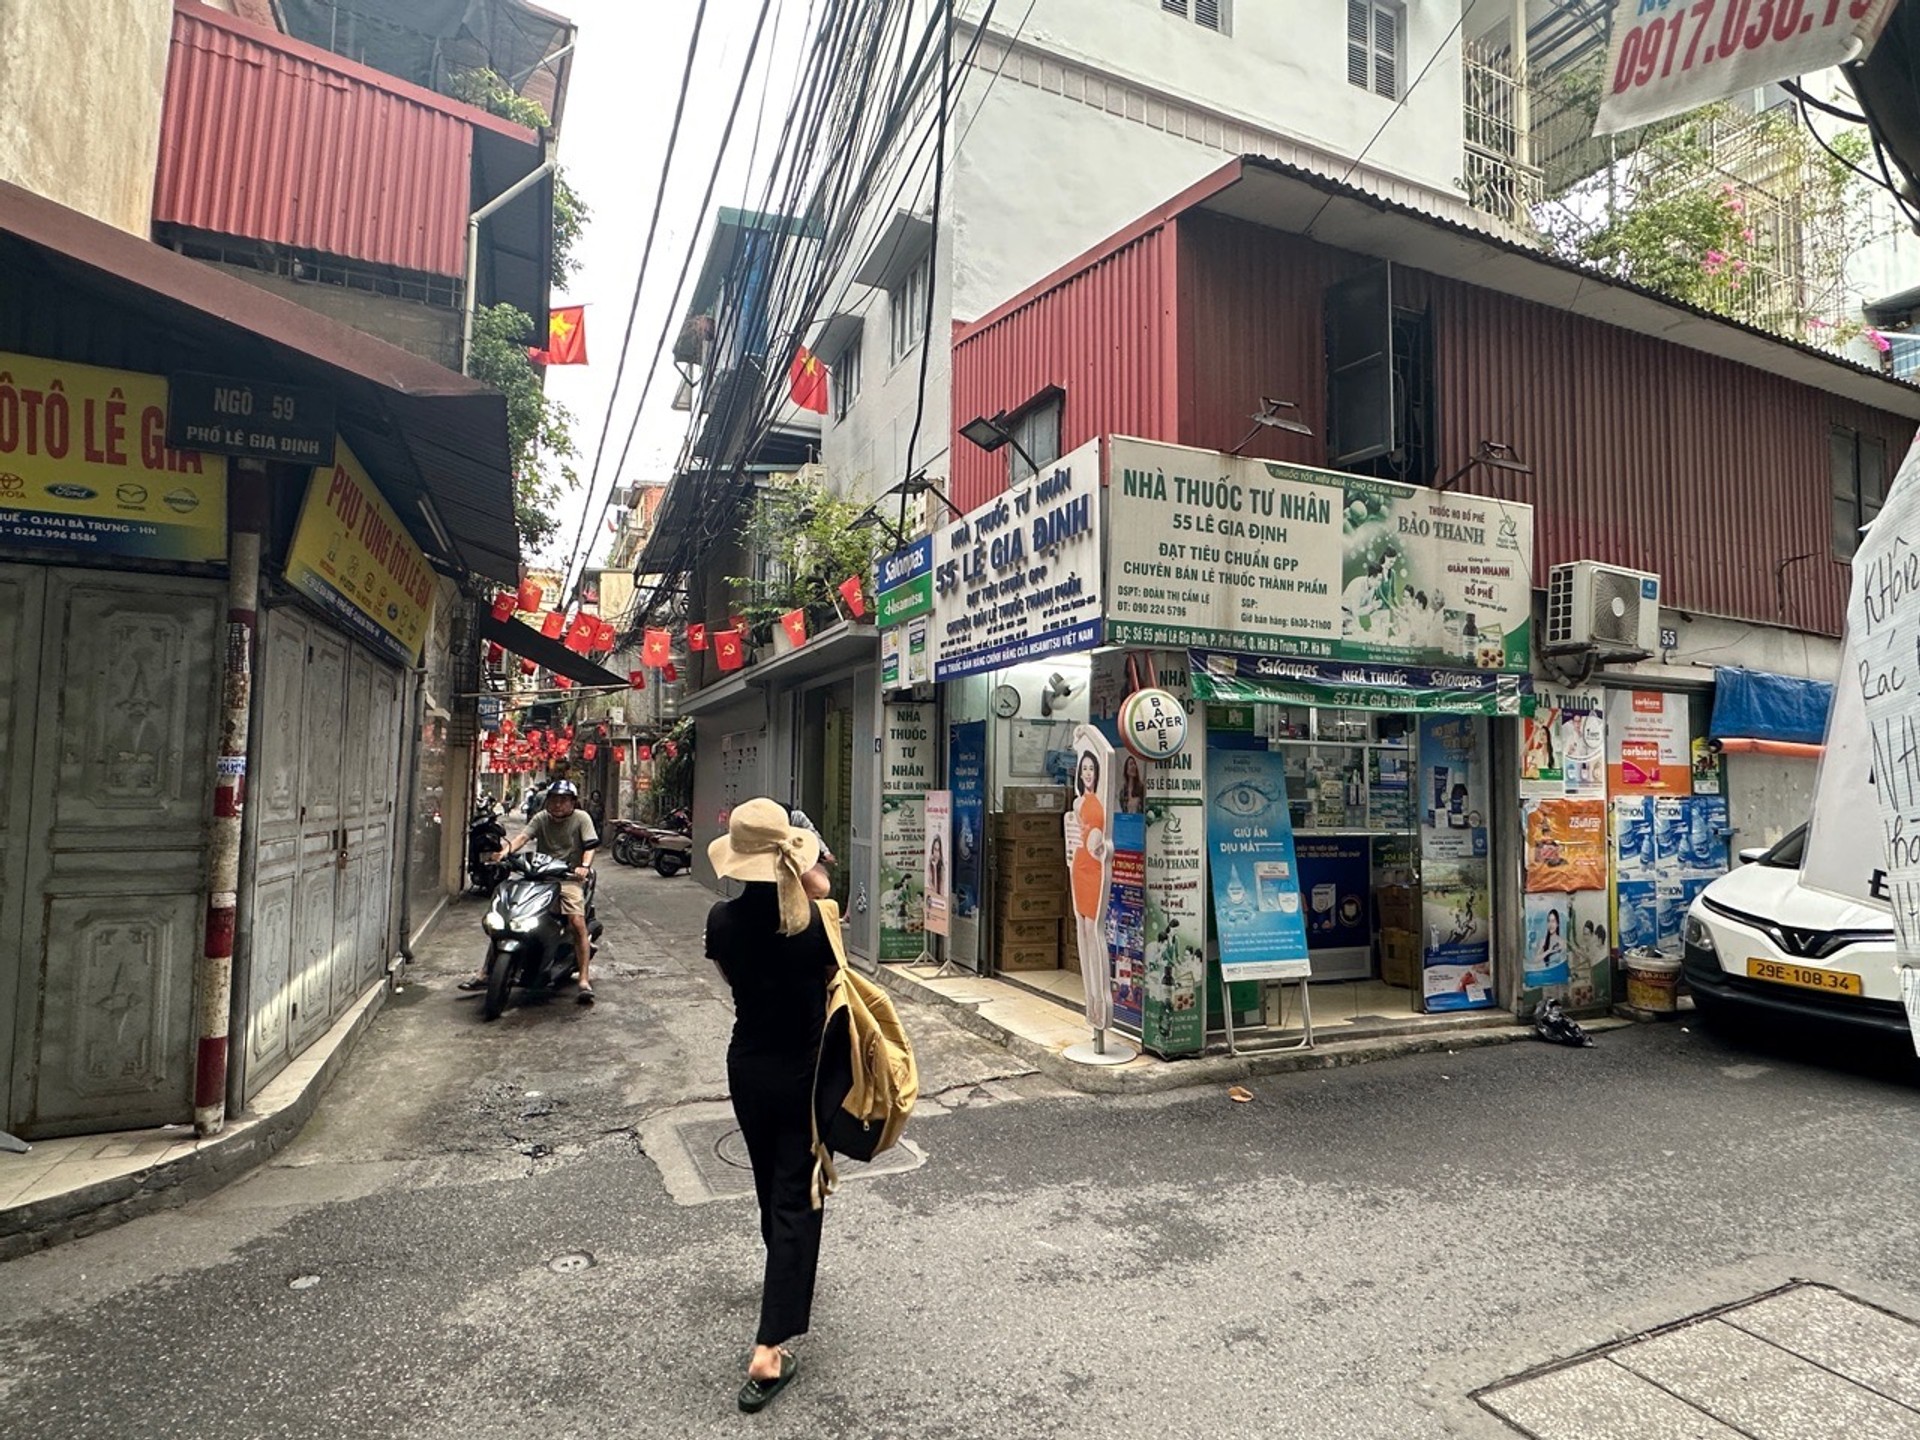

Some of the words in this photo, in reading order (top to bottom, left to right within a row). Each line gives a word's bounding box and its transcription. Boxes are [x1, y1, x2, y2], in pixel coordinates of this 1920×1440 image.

[272, 395, 295, 421] 59
[84, 387, 127, 466] LÊ
[187, 425, 222, 443] PHỐ
[225, 429, 244, 445] LÊ
[250, 434, 276, 450] GIA
[281, 437, 320, 457] ĐỊNH
[1036, 467, 1071, 505] NHÂN
[1123, 468, 1167, 501] NHÀ
[1174, 475, 1242, 514] THUỐC
[1249, 487, 1275, 517] TƯ
[1281, 491, 1330, 524] NHÂN
[326, 463, 363, 538] PHỤ
[68, 519, 85, 529] BÀ
[87, 521, 130, 533] TRƯNG
[139, 526, 157, 535] HN
[1172, 514, 1192, 530] 55
[1196, 514, 1214, 533] LÊ
[1218, 519, 1245, 538] GIA
[1249, 523, 1287, 544] ĐỊNH
[1398, 511, 1430, 536] BẢO
[1433, 521, 1485, 545] THANH
[936, 559, 958, 593] 55
[991, 527, 1024, 570] GIA
[1033, 493, 1089, 557] ĐỊNH
[1159, 542, 1186, 560] ĐẠT
[1190, 544, 1220, 562] TIÊU
[1225, 548, 1269, 569] CHUẨN
[1273, 556, 1299, 572] GPP
[1123, 561, 1171, 578] CHUYÊN
[1175, 565, 1198, 581] BÁN
[1202, 567, 1215, 583] LẺ
[1218, 571, 1255, 587] THUỐC
[1259, 576, 1294, 592] THÀNH
[1297, 577, 1328, 595] PHẨM
[1470, 565, 1480, 575] HO
[1482, 565, 1510, 577] NHANH
[1167, 589, 1181, 603] THỊ
[1132, 602, 1148, 614] 090
[1150, 604, 1166, 616] 224
[1029, 635, 1062, 655] HISAMITSU
[1062, 631, 1077, 648] VIỆT
[1078, 627, 1094, 643] NAM
[1144, 628, 1153, 643] 55
[1178, 631, 1190, 645] Gia
[1662, 630, 1675, 646] 55
[1159, 667, 1187, 688] NHÀ
[1255, 657, 1318, 679] Salonpas
[1342, 667, 1366, 683] NHÀ
[1370, 669, 1408, 686] THUỐC
[1429, 670, 1482, 690] Salonpas
[1333, 691, 1349, 705] 55
[1369, 692, 1387, 707] GIA
[890, 727, 927, 740] THUỐC
[1136, 715, 1183, 732] BAYER
[1150, 697, 1169, 752] BAYER
[901, 747, 916, 758] TƯ
[892, 763, 924, 776] NHÂN
[1147, 778, 1155, 791] 55
[1166, 779, 1180, 791] GIA
[1240, 840, 1260, 852] MẮT
[1148, 854, 1164, 868] BẢO
[1166, 858, 1199, 869] THANH
[1756, 963, 1850, 990] 29E-108.34
